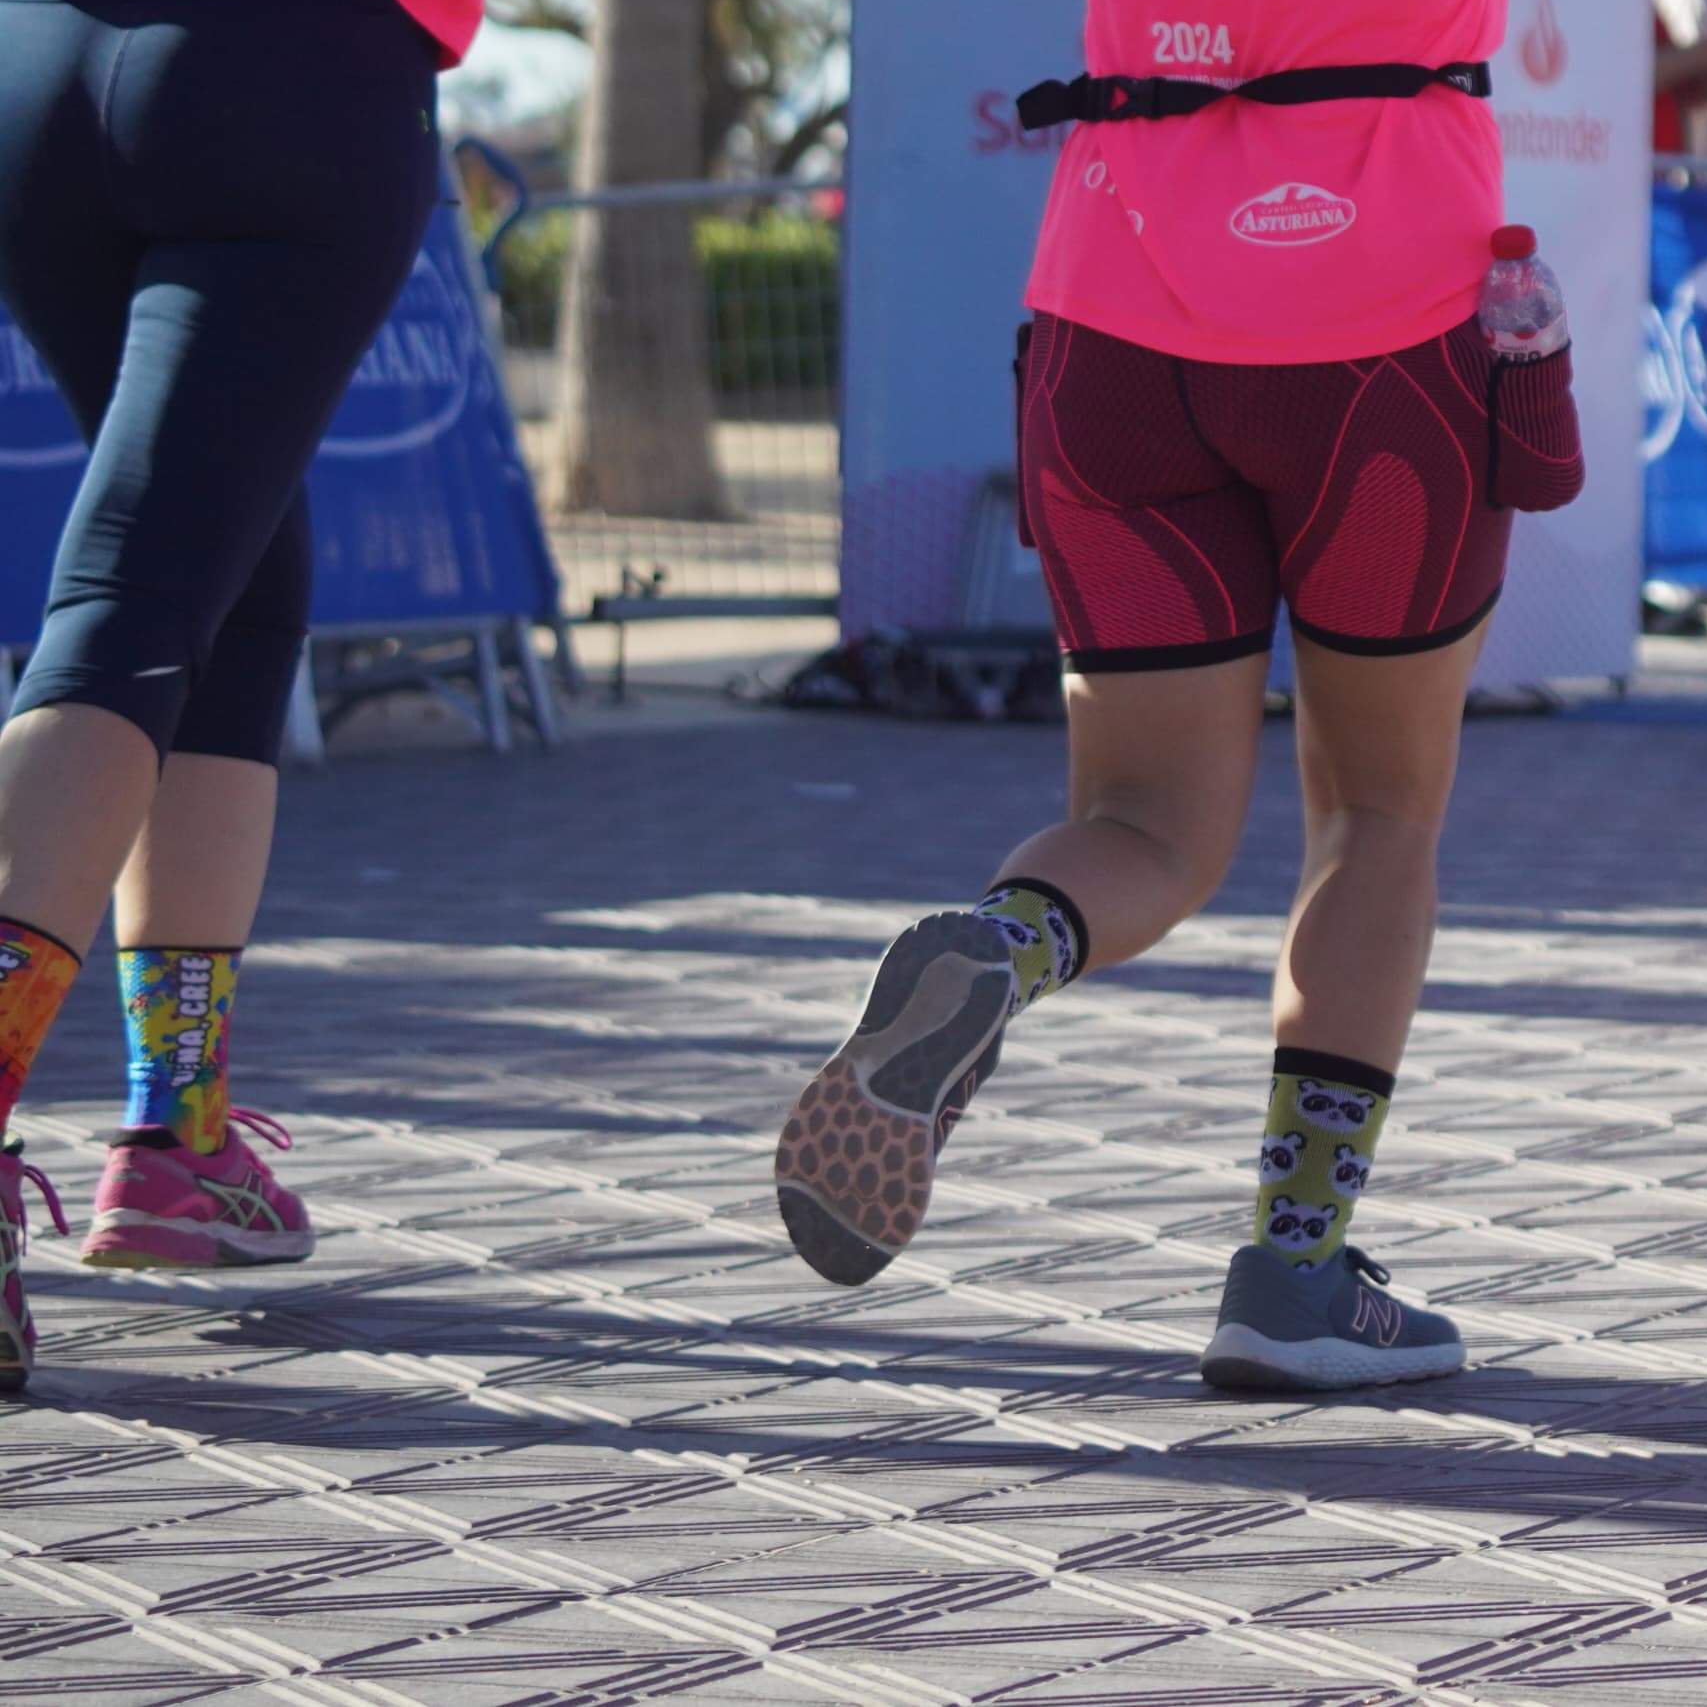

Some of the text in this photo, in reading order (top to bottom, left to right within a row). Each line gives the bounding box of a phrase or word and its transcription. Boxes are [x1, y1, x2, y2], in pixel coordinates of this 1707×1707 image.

[1152, 22, 1235, 65] 2024
[1240, 208, 1346, 231] ASTURIANA
[178, 956, 214, 1017] CREE
